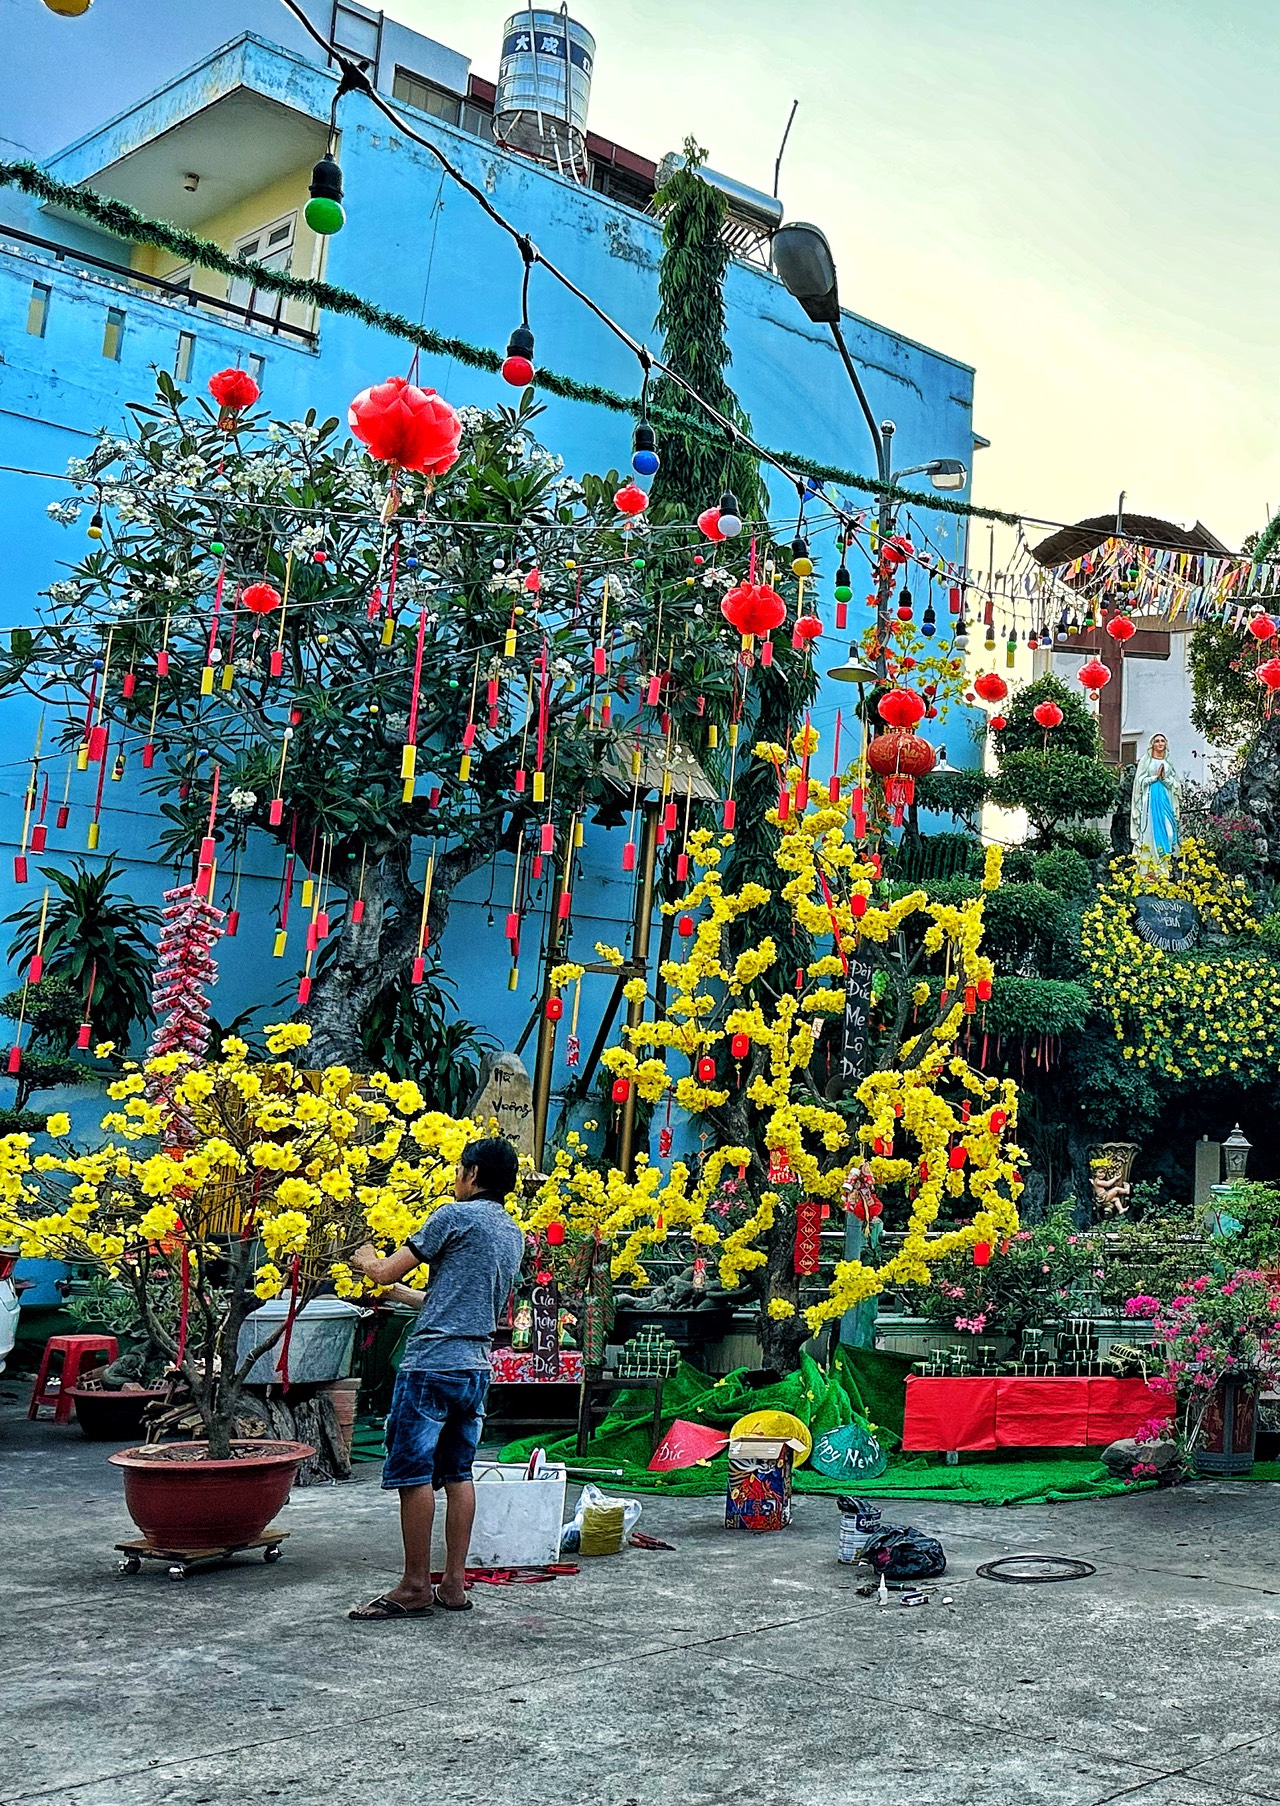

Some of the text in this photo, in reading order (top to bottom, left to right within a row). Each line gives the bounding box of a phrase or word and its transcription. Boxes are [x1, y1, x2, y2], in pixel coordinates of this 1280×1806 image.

[845, 1002, 866, 1031] Mẹ
[844, 1029, 865, 1055] Lộ
[531, 1286, 555, 1306] Cửa
[537, 1330, 556, 1352] Lộ
[842, 1447, 875, 1469] New
